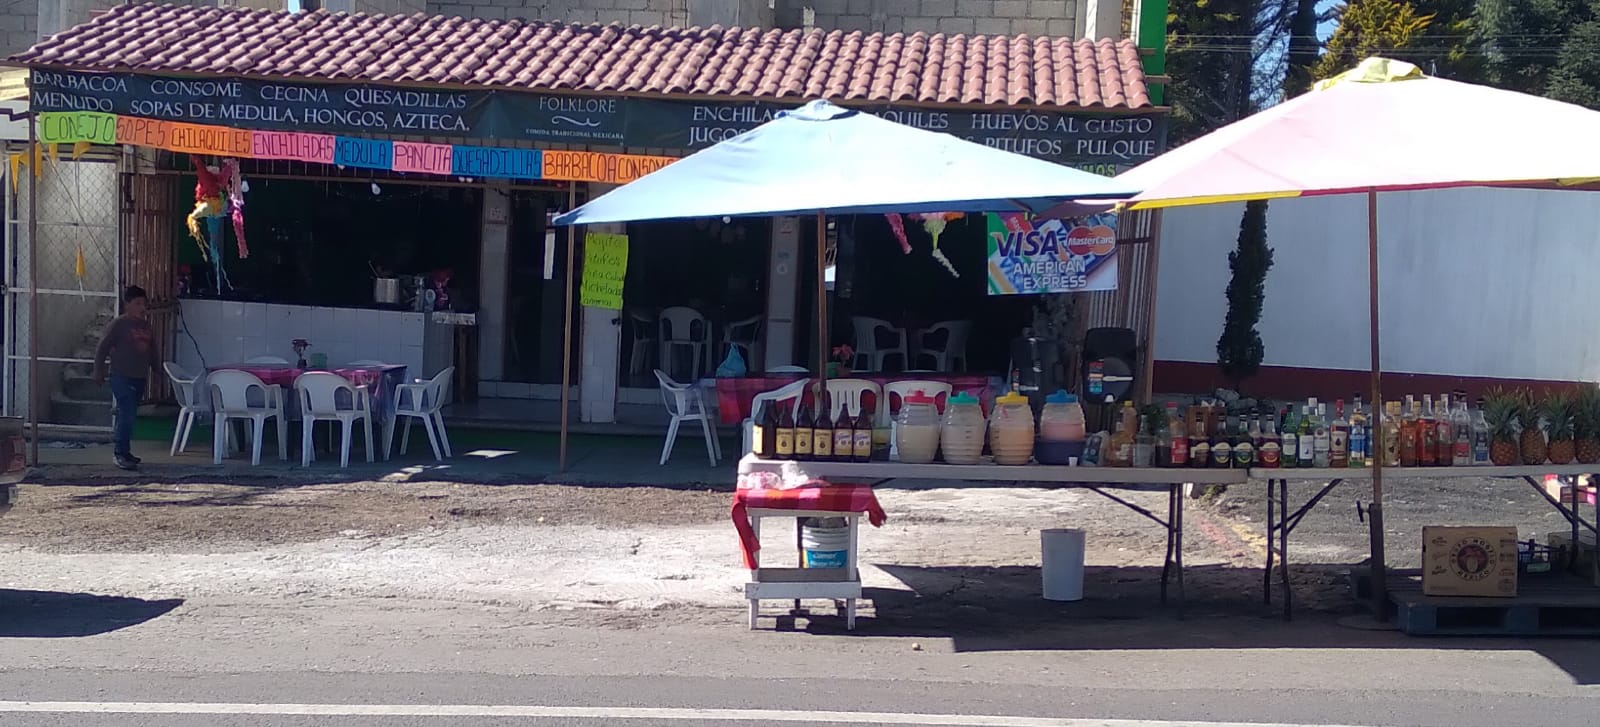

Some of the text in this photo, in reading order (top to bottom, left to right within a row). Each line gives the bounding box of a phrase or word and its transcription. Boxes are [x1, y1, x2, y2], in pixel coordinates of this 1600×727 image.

[33, 70, 467, 108] BARBACOA CONSOME CECINA QUESADILLAS
[33, 91, 470, 131] MENUDO SOPAS DE MEDULA, HONGOS, AZTECA.
[539, 96, 616, 113] FOLKLORE
[44, 114, 115, 142] CONEJO
[116, 117, 166, 146] SOPES
[693, 106, 778, 123] ENCHILA
[971, 113, 1049, 131] HUEVOS
[1054, 115, 1079, 132] AL
[1085, 117, 1152, 134] GUSTO
[171, 127, 251, 153] CHILAQUILES
[253, 133, 334, 160] ENCHILADAS
[525, 128, 550, 136] COMIDA
[593, 131, 624, 139] MEXICANA
[335, 141, 388, 165] MEDULA
[394, 144, 451, 172] PANCITA
[985, 137, 1062, 155] PITUFOS
[1076, 139, 1155, 160] PULQUE
[452, 148, 541, 176] QUESADILLAS
[543, 152, 617, 182] BARBACOA
[990, 231, 1061, 257] VISA
[1068, 236, 1115, 247] MasterCard
[1013, 261, 1086, 275] AMERICAN
[1023, 275, 1087, 289] EXPRESS
